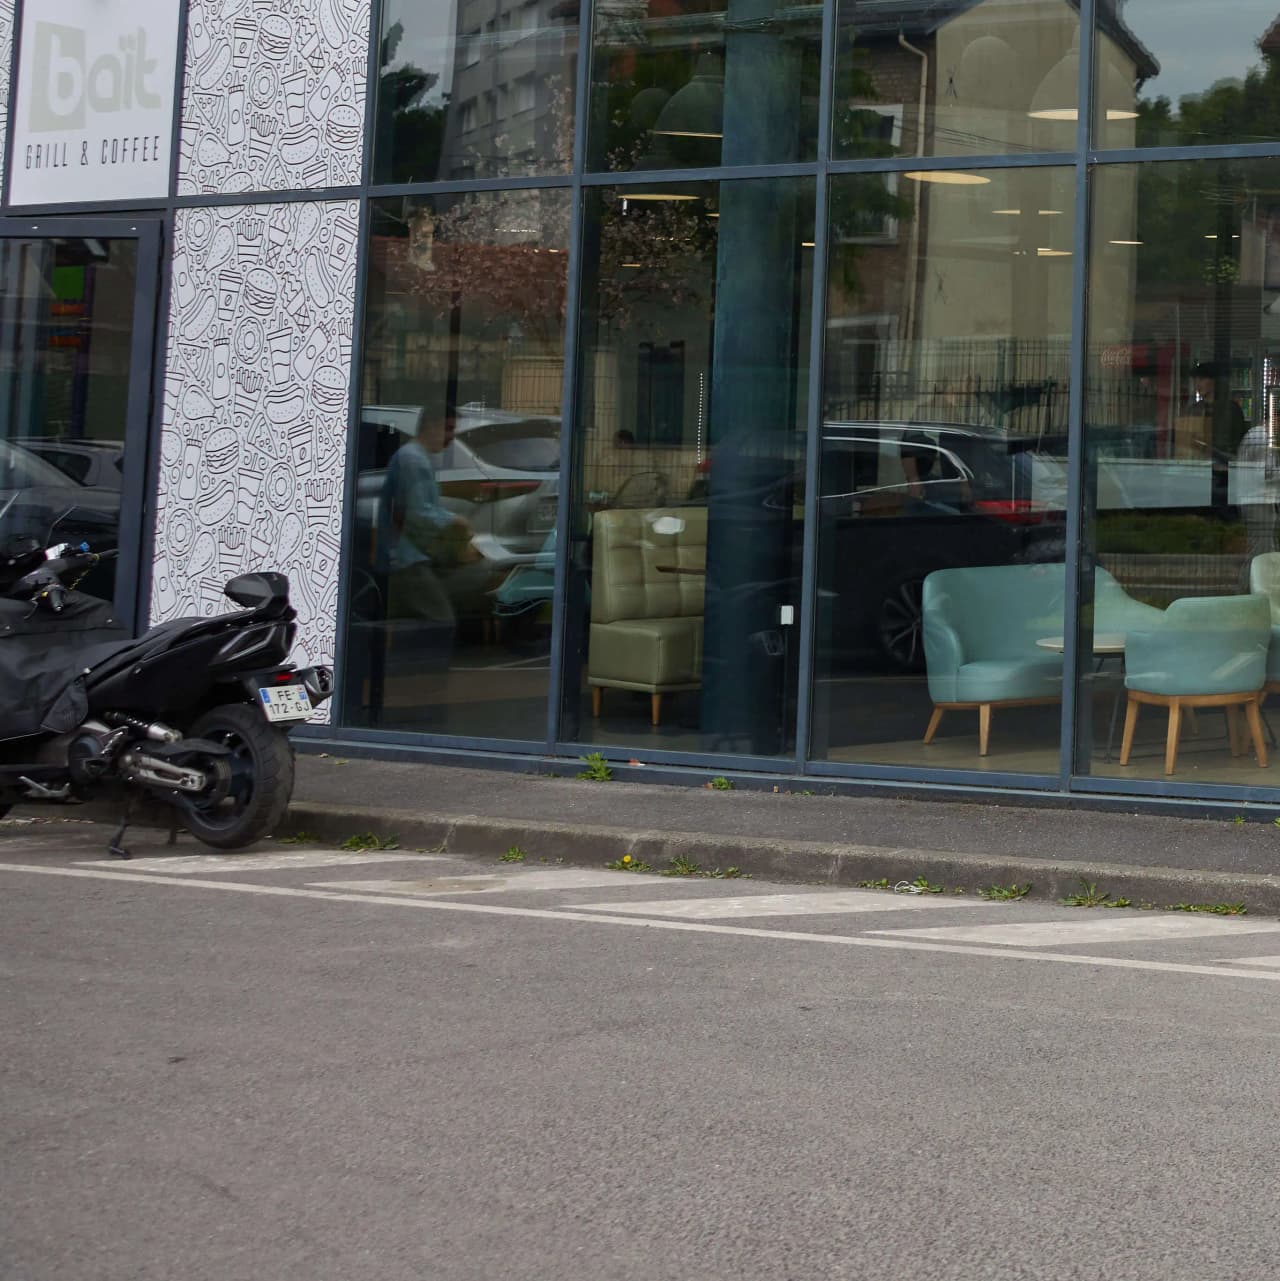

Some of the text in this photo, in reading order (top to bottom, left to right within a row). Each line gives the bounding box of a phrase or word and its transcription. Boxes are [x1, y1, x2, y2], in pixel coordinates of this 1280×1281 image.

[26, 136, 160, 169] GRILL & COFFEE
